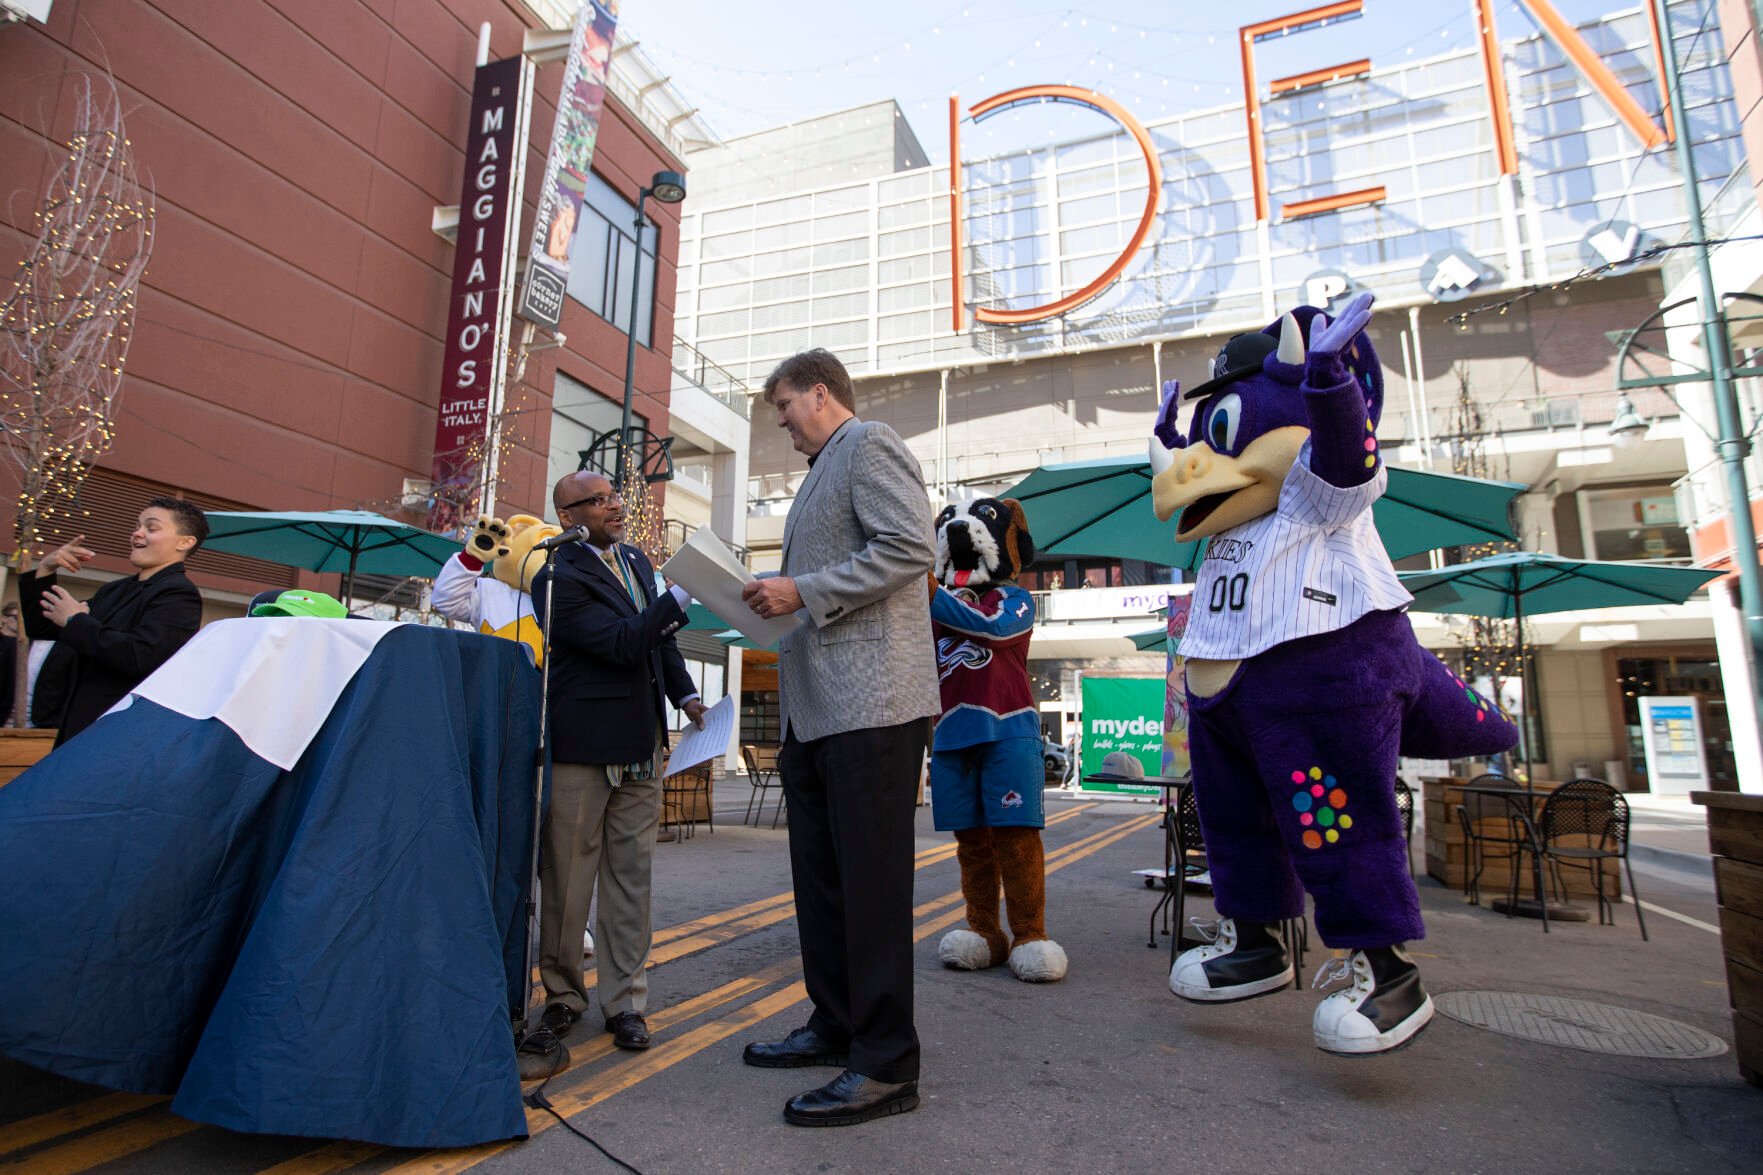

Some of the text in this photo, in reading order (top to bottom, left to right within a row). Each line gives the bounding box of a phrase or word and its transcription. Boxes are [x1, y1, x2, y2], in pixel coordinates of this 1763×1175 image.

[532, 200, 552, 261] SWEETS
[456, 106, 504, 388] MAGGIANO'S
[531, 287, 558, 310] bakery
[532, 280, 560, 302] corner
[442, 398, 487, 414] LITTLE
[1209, 573, 1249, 612] 00
